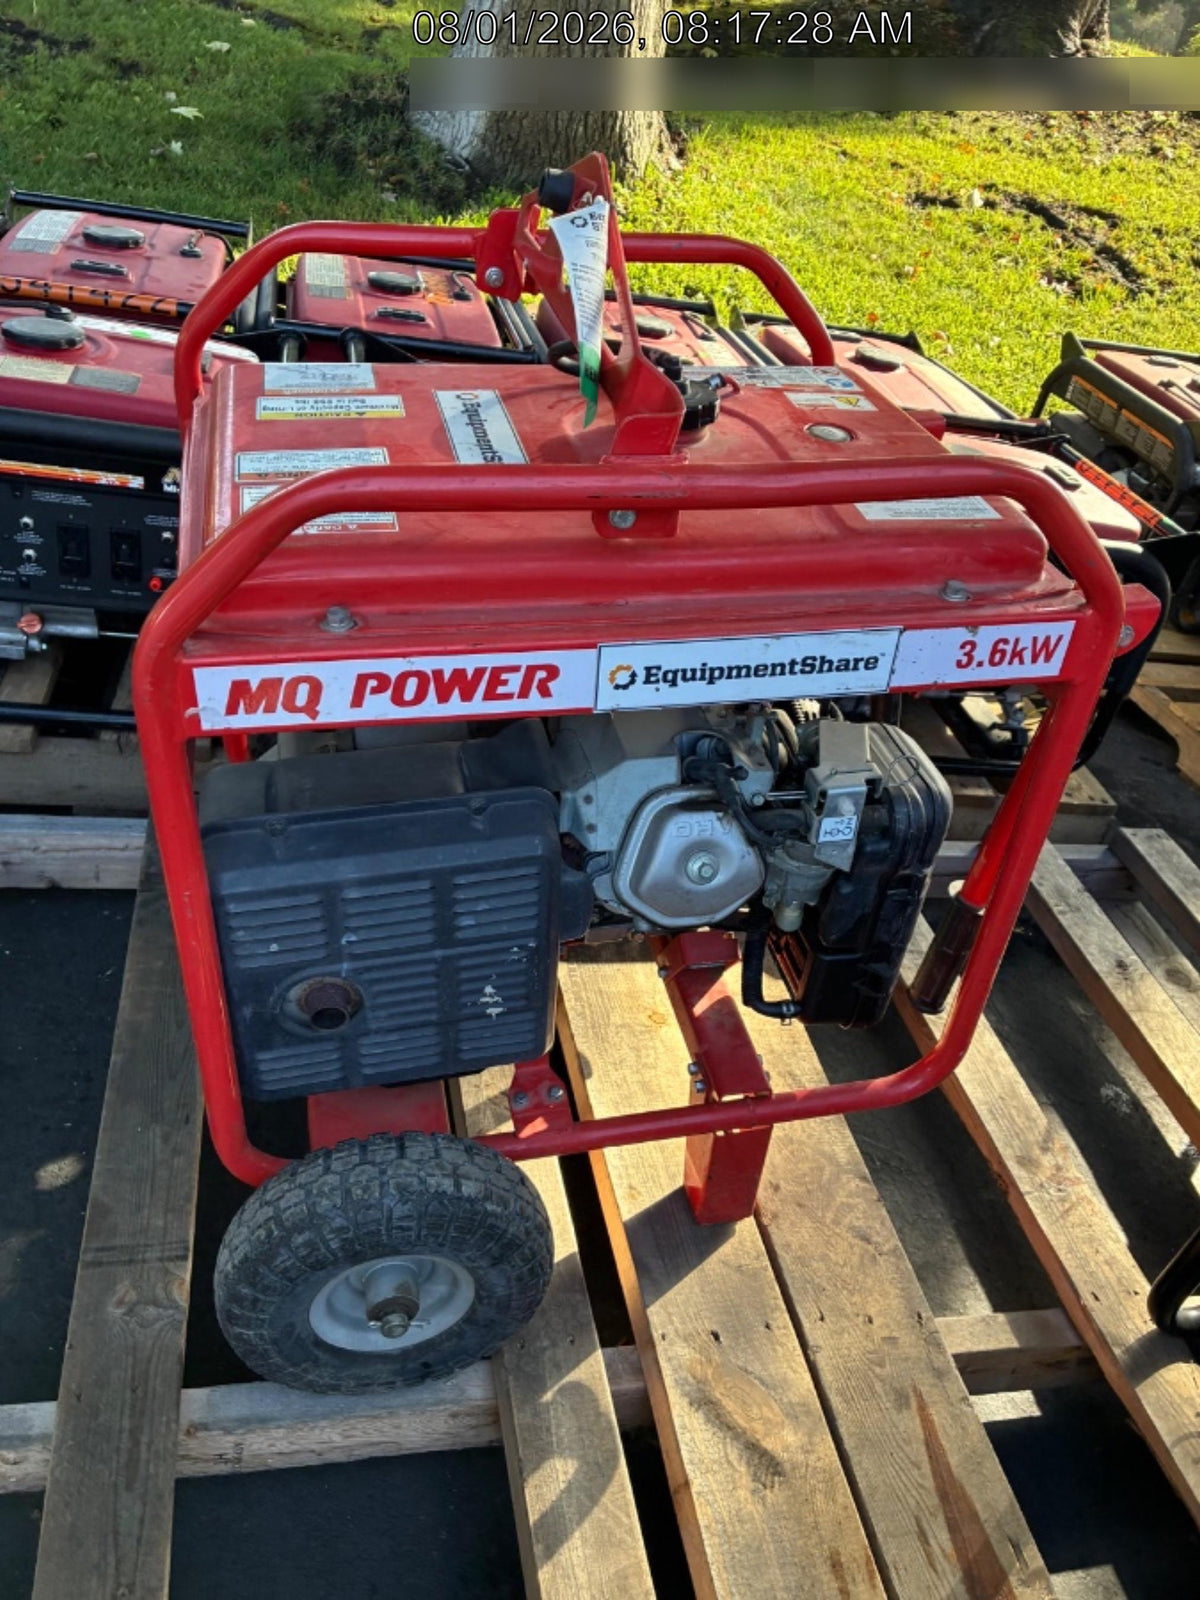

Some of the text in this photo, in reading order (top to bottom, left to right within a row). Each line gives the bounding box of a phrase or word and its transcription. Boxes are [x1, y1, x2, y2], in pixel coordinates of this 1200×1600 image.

[460, 401, 504, 464] EquipmentS
[642, 654, 880, 686] EquipmentShare
[955, 633, 1064, 672] 3.6kW
[224, 663, 561, 721] MQ POWER
